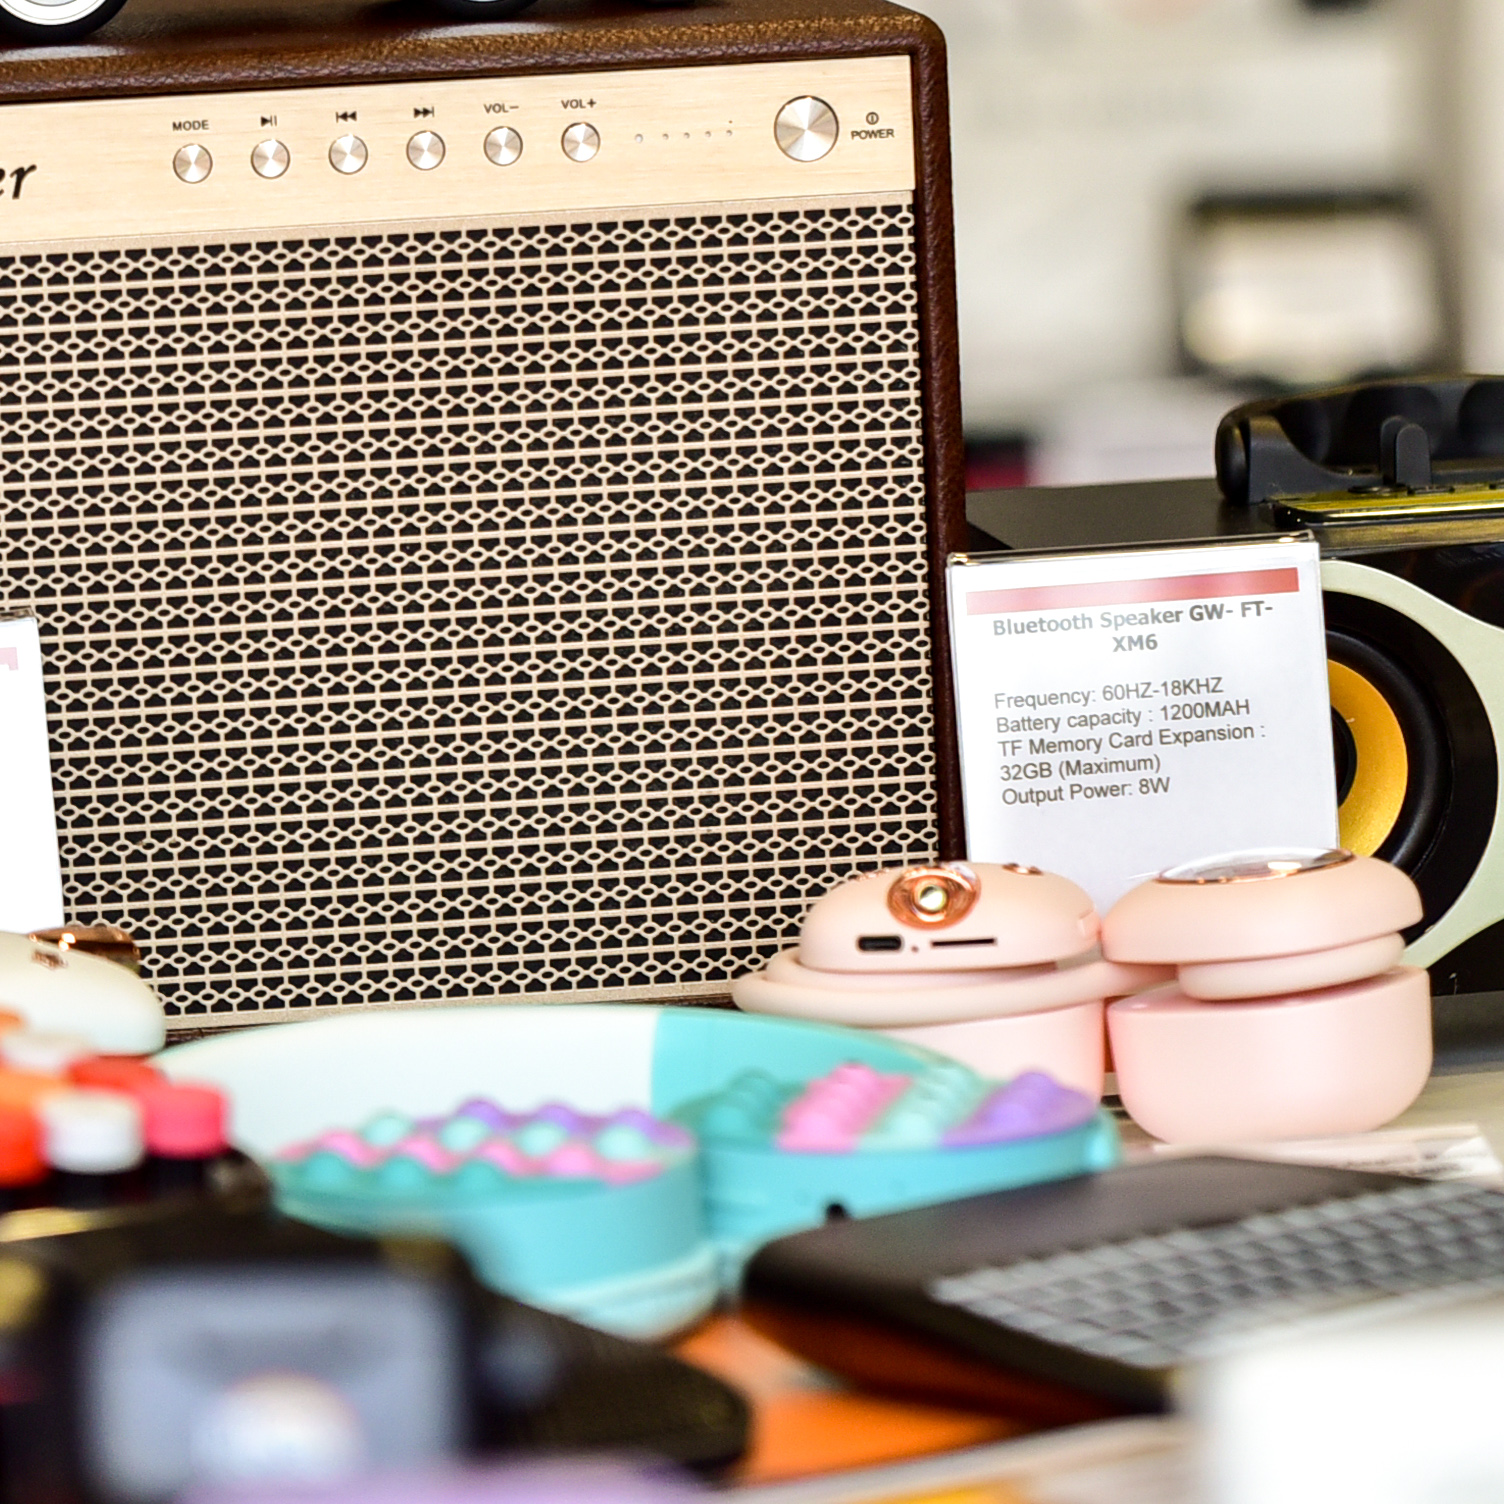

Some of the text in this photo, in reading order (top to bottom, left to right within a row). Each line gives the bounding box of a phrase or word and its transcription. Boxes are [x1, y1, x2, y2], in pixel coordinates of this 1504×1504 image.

[172, 119, 210, 132] MODE
[850, 128, 895, 140] POWER
[993, 600, 1273, 636] Bluetooth Speaker GW- FT-
[1112, 634, 1158, 653] XM6
[994, 676, 1224, 710] Frequency: 60HZ-18KHZ
[996, 716, 1061, 734] Battery
[1067, 708, 1141, 729] capacity
[1159, 699, 1251, 721] 1200MAH
[998, 739, 1023, 757] TF
[1029, 735, 1102, 755] Memory
[1108, 730, 1153, 750] Card
[1159, 723, 1255, 748] Expansion
[1000, 754, 1161, 781] 32GB (Maximum)
[1001, 776, 1171, 807] Output Power: 8W
